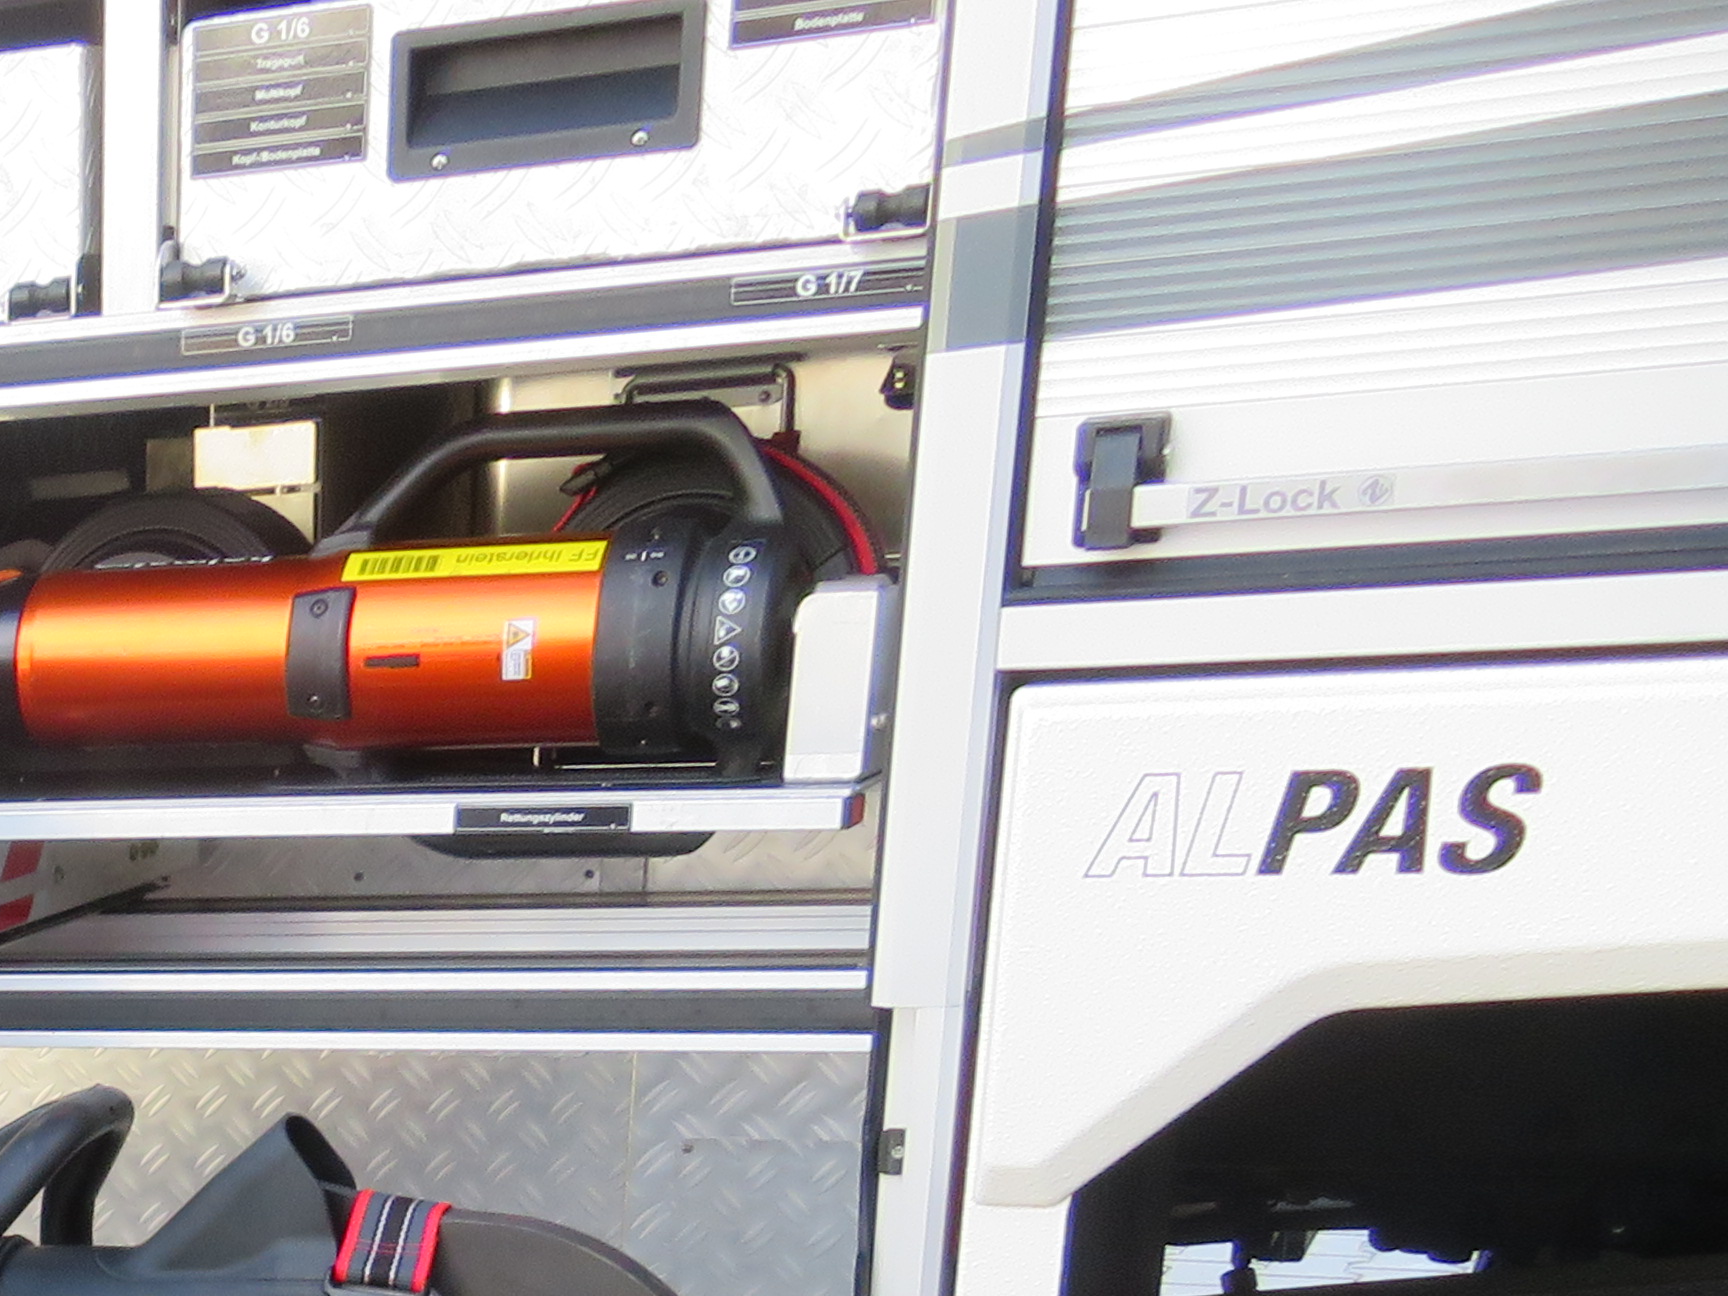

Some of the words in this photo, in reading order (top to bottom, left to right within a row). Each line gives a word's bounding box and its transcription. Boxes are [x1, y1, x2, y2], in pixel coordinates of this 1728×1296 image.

[251, 22, 270, 44] G
[277, 16, 310, 41] 1/6
[796, 274, 818, 297] G
[825, 269, 865, 295] 1/7
[237, 326, 256, 347] G
[263, 322, 296, 345] 1/6
[1189, 480, 1341, 519] Z-Lock
[455, 547, 562, 565] Ihrlerstein
[568, 546, 600, 562] FF
[1083, 762, 1544, 879] ALPAS
